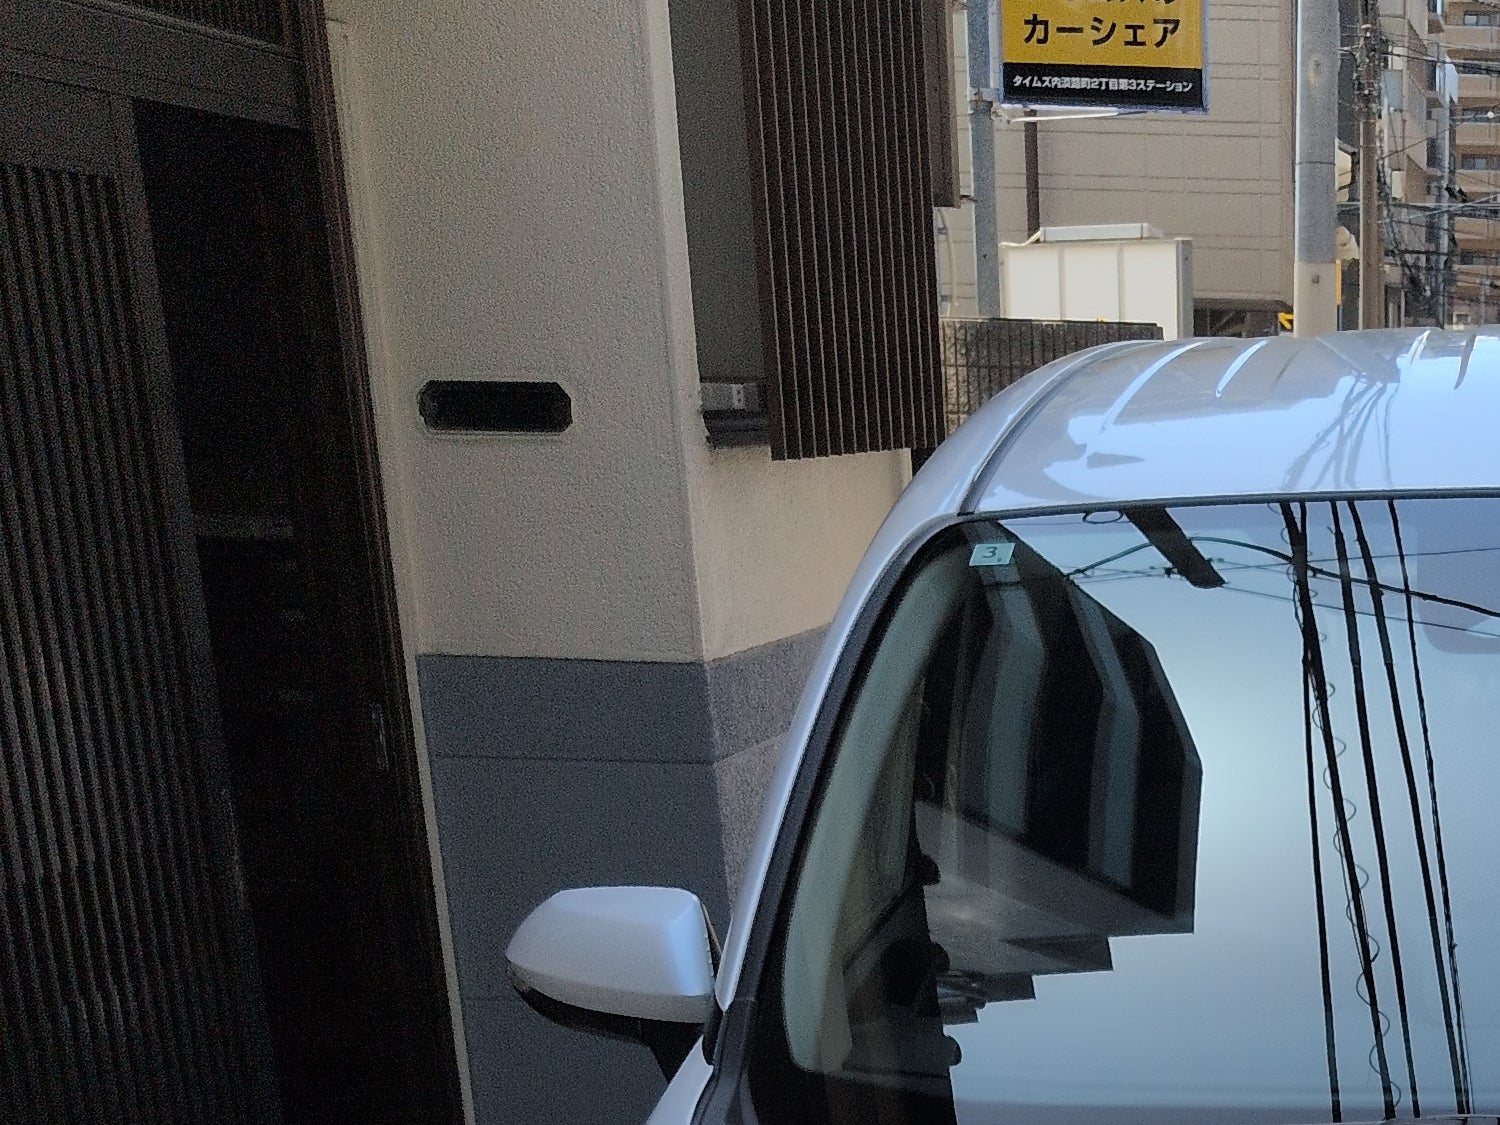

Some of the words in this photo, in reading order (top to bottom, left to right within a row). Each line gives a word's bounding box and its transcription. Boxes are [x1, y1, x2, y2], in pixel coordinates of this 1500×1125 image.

[1024, 14, 1181, 48] カーシェア
[982, 546, 998, 558] 3
